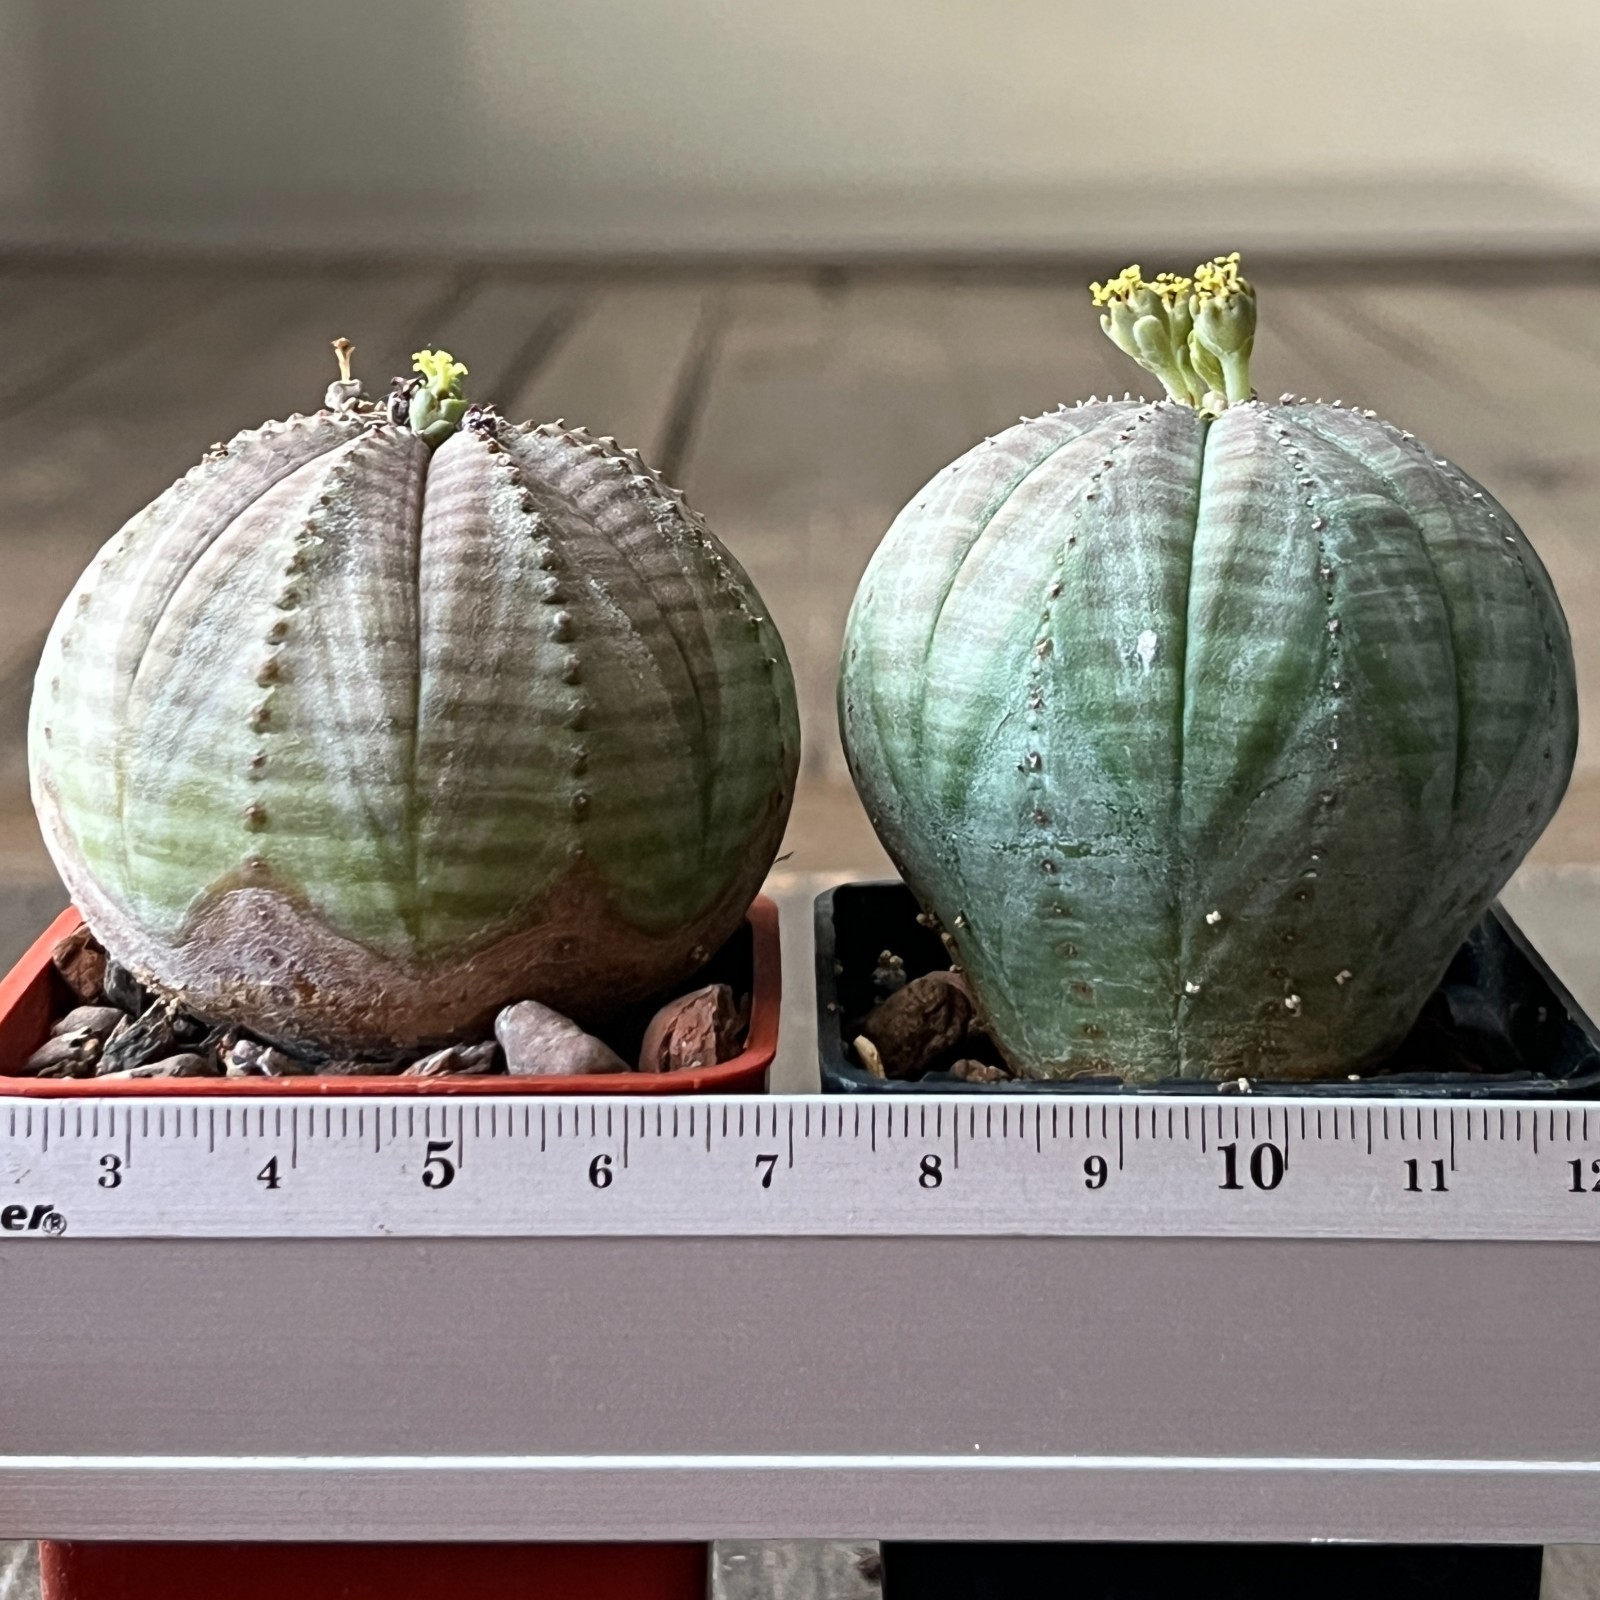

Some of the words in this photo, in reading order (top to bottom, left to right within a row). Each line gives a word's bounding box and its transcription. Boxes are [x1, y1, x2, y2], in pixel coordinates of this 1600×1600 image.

[98, 1154, 122, 1189] 3
[256, 1155, 281, 1190] 4
[421, 1140, 455, 1190] 5
[588, 1154, 613, 1189] 6
[755, 1154, 779, 1189] 7
[918, 1154, 943, 1189] 8
[1083, 1155, 1108, 1190] 9
[1217, 1142, 1284, 1190] 10
[1403, 1158, 1449, 1192] 11
